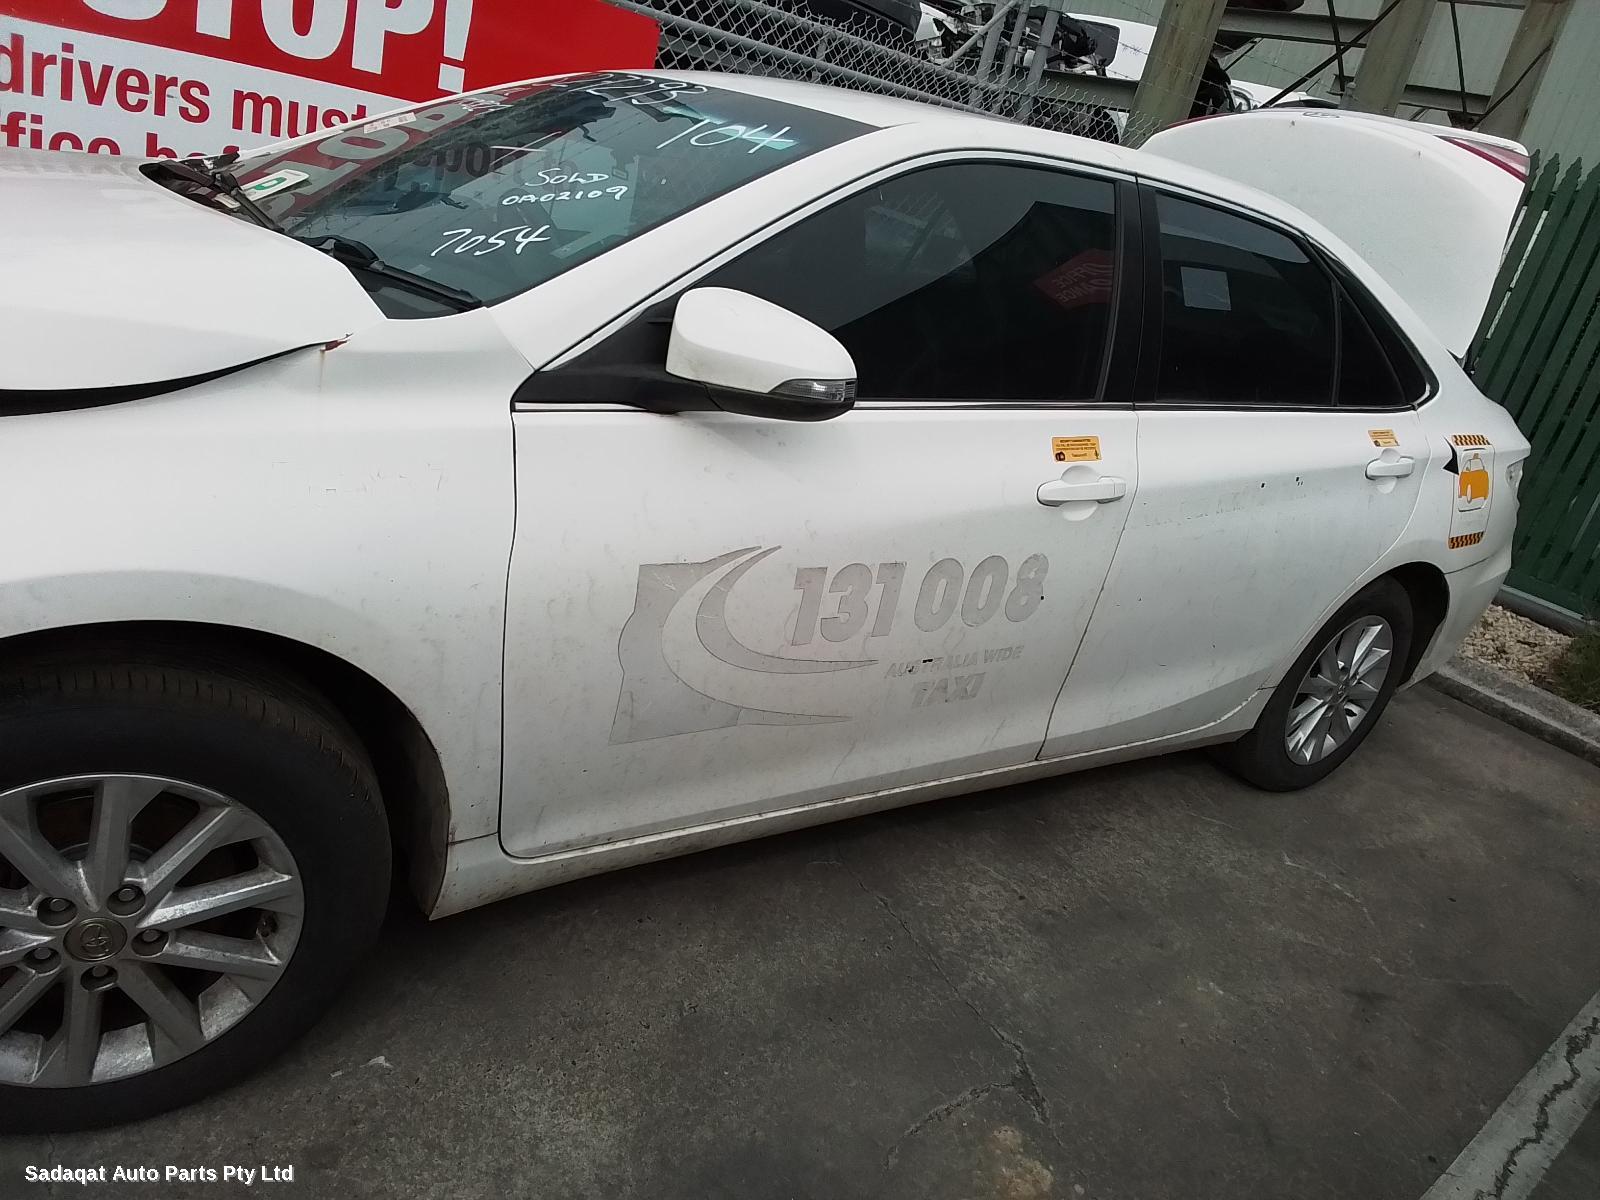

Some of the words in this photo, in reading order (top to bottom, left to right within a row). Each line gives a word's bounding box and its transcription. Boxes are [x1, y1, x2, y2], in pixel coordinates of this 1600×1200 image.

[0, 33, 210, 123] drivers
[430, 225, 551, 257] 7054
[791, 562, 907, 647] 131
[914, 553, 1050, 632] 008
[983, 645, 1025, 664] WIDE
[911, 671, 987, 709] TAXI
